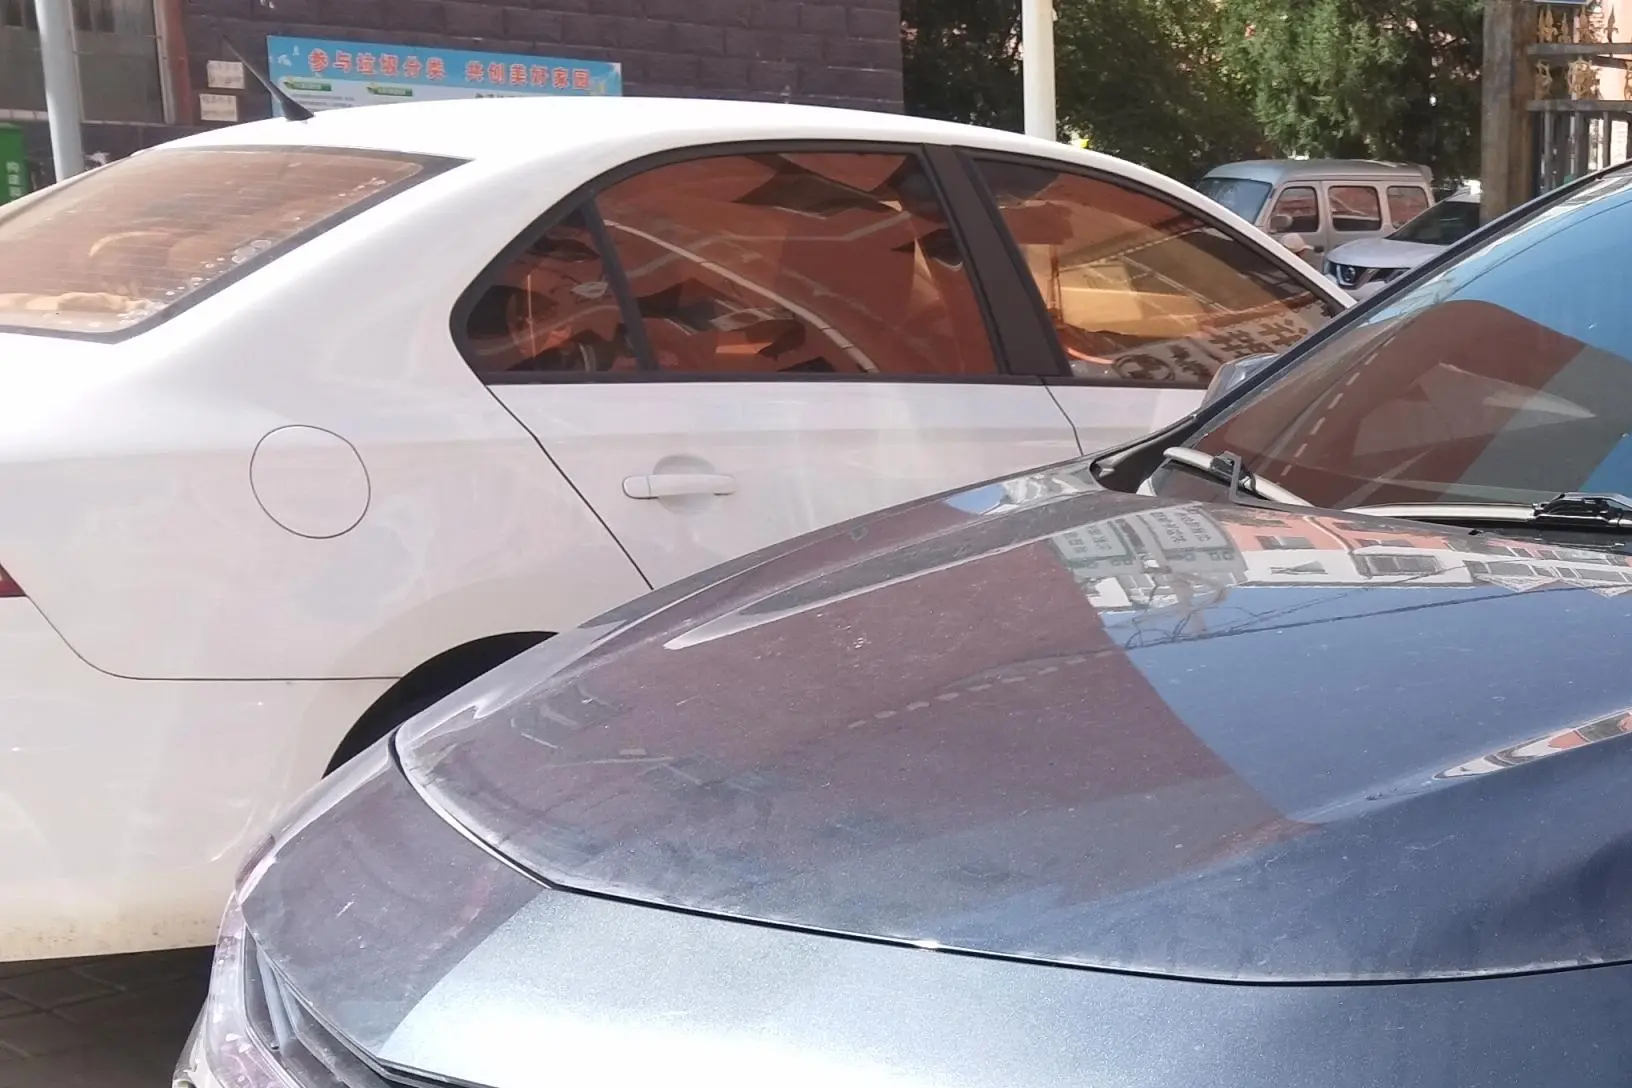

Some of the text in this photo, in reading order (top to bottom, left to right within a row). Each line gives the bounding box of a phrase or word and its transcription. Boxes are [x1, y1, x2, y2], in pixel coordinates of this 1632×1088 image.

[308, 48, 592, 90] 参与垃圾分类 共创美好家园
